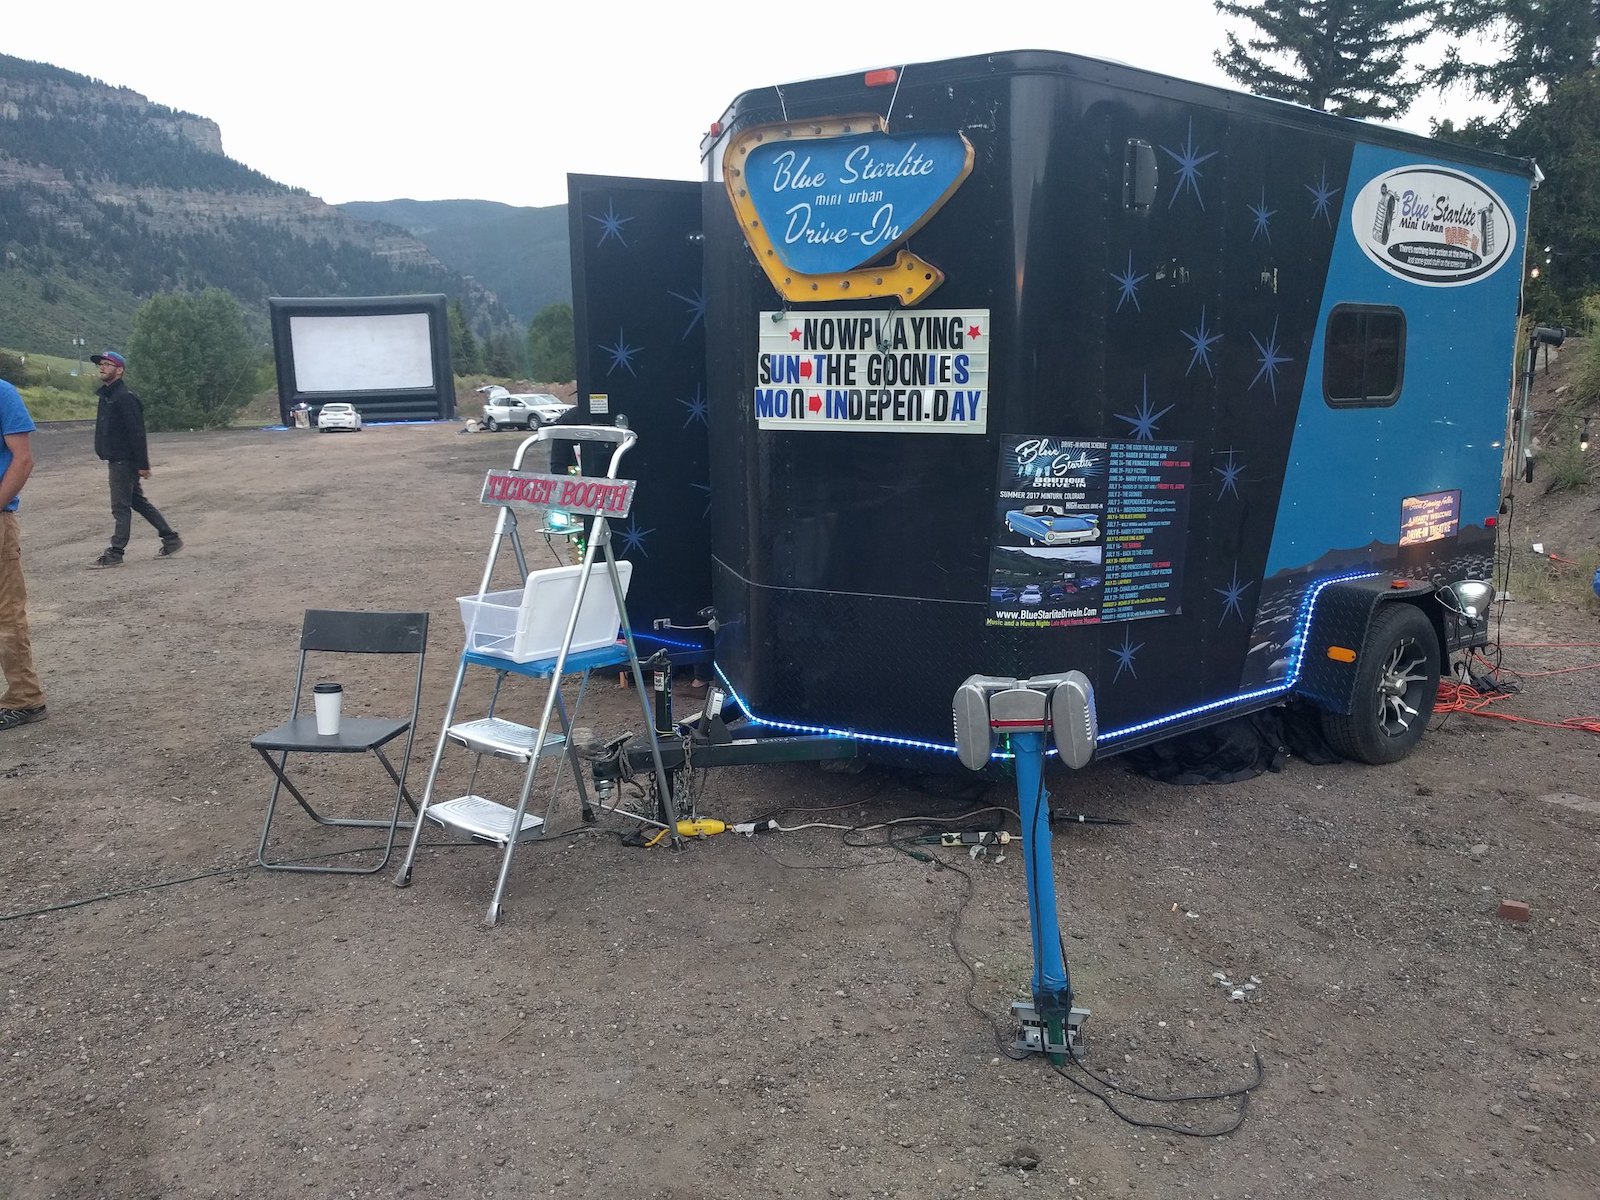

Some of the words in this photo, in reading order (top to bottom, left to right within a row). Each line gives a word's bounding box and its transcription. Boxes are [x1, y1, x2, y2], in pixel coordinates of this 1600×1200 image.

[772, 150, 827, 193] Blue
[839, 142, 935, 185] Starlite
[814, 193, 841, 206] mini
[847, 190, 883, 205] urban
[1401, 189, 1429, 220] Blue
[1433, 196, 1476, 226] Starlite
[784, 203, 903, 246] Drive-In
[1399, 217, 1418, 230] Mini
[1421, 220, 1444, 233] Urban
[759, 353, 800, 385] SUN
[812, 353, 857, 386] THE
[1014, 438, 1060, 464] Blue
[1052, 451, 1100, 476] Starlite
[488, 475, 557, 505] TICKET
[558, 480, 629, 512] BOOTH
[999, 490, 1026, 499] SUMMER
[1026, 491, 1040, 500] 2017
[1065, 501, 1077, 509] HIGH
[986, 618, 1003, 626] Music
[1036, 620, 1051, 628] Nights
[995, 607, 1097, 620] www.BlueStarliteDriveIn.Com
